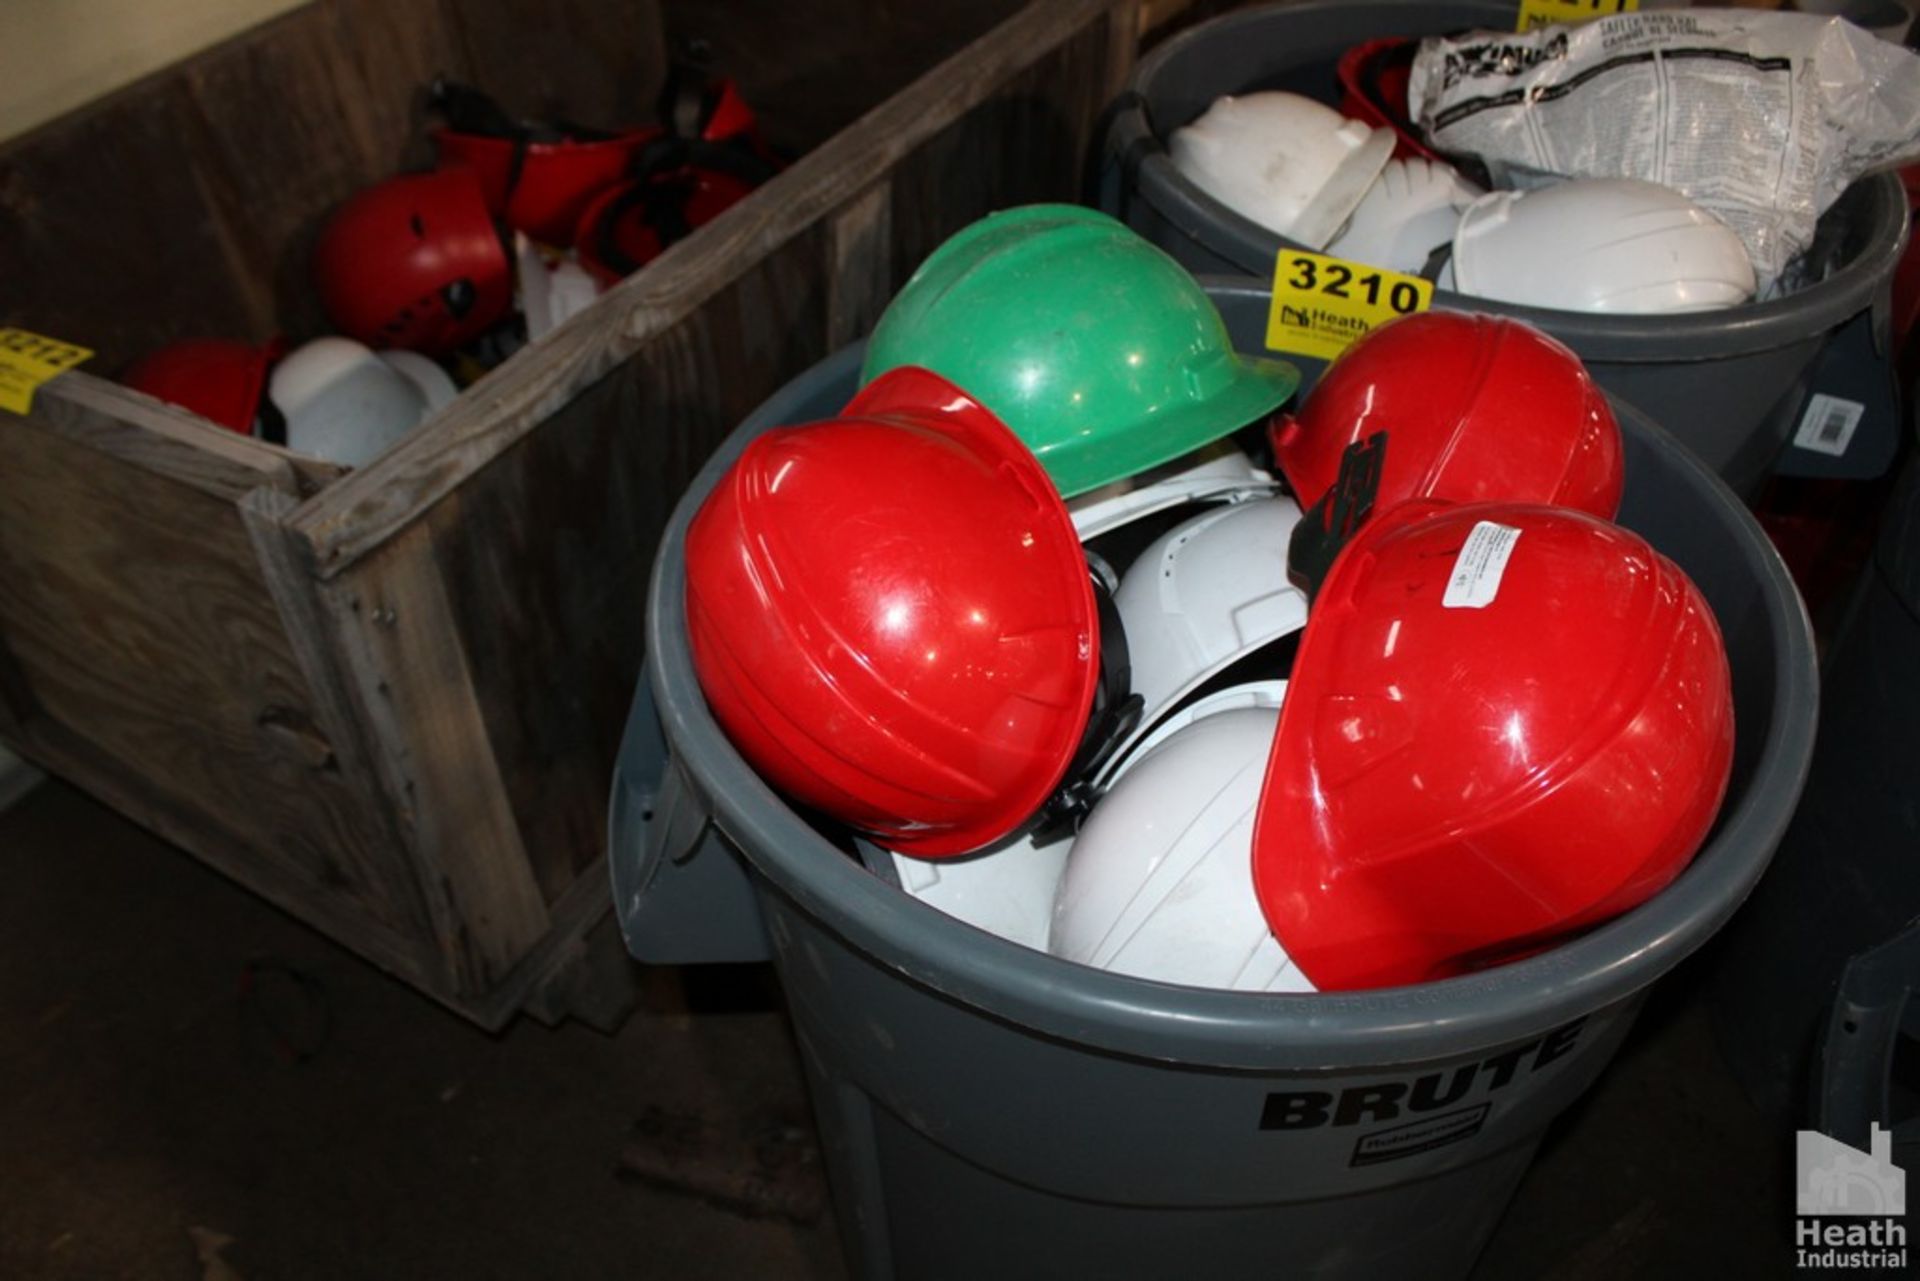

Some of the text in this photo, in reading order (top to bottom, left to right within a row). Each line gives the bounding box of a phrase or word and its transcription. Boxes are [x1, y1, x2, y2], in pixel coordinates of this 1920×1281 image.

[1288, 258, 1420, 314] 3210
[1312, 307, 1370, 334] Heath
[1258, 1014, 1590, 1131] BRUTE
